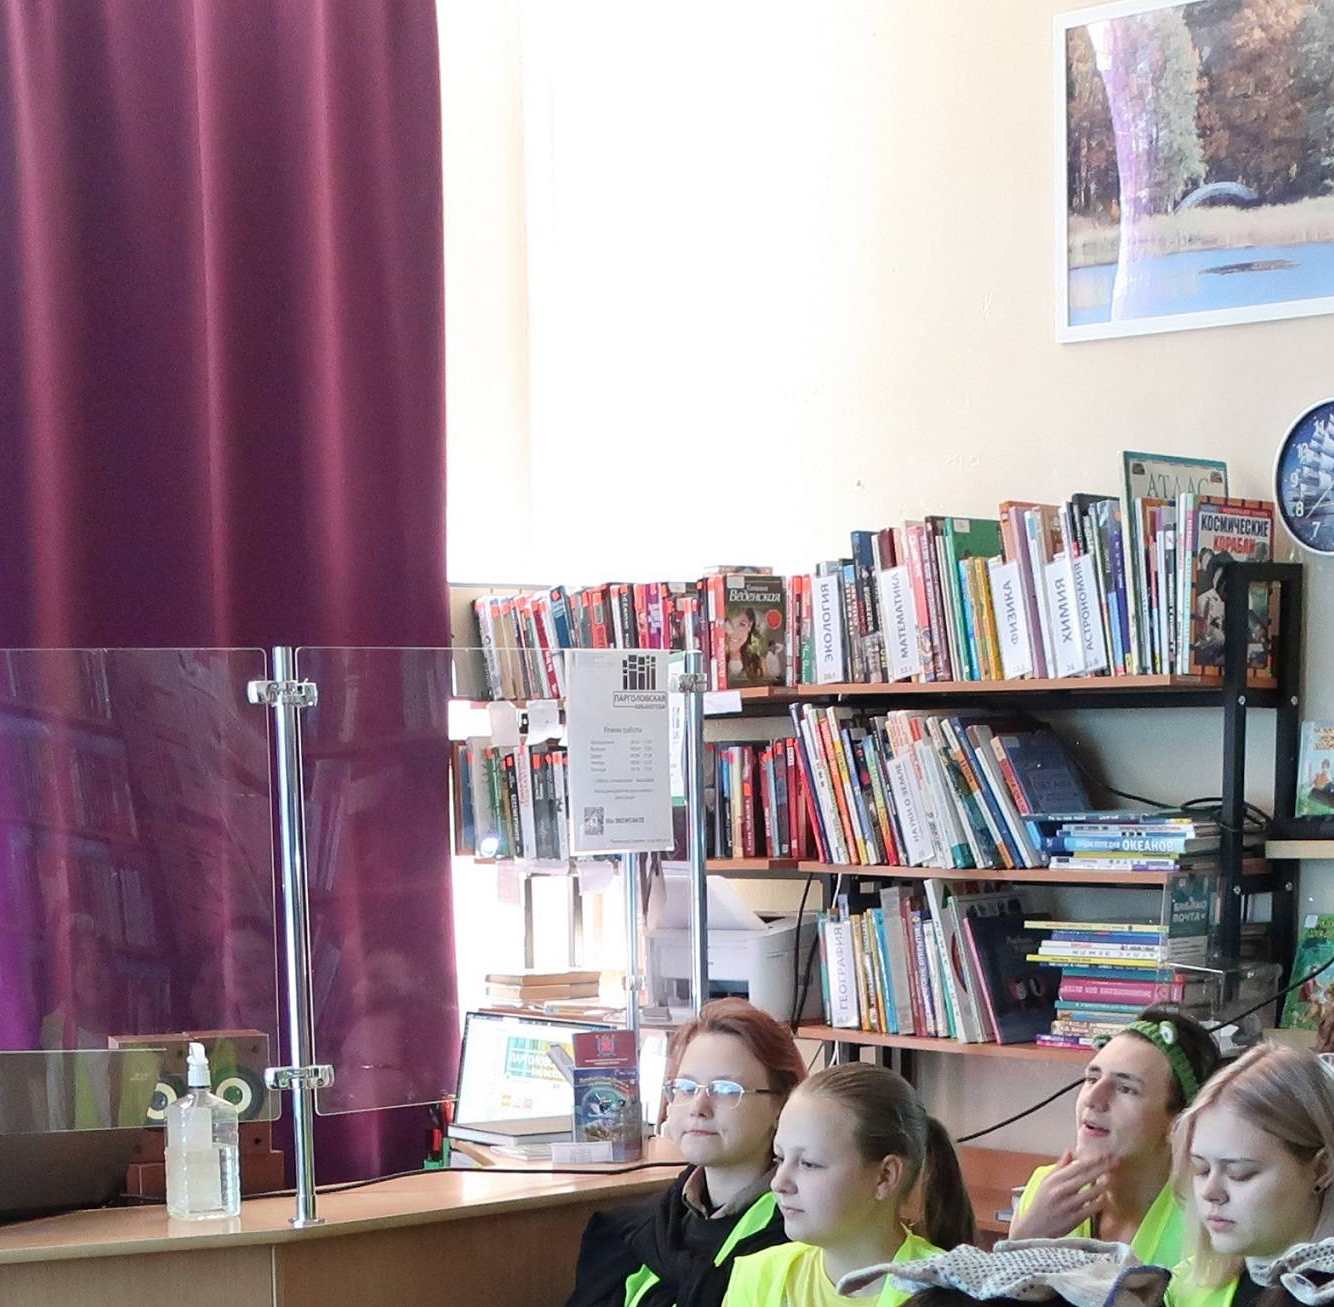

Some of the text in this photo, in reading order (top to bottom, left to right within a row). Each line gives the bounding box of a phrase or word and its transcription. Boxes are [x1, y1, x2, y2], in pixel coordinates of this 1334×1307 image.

[1147, 474, 1209, 499] АТЛАС
[1290, 474, 1299, 487] 9
[1295, 501, 1304, 517] 8
[1200, 513, 1269, 537] КОСМИЧЕСКИЕ
[1311, 521, 1321, 538] 7
[1213, 535, 1256, 556] КОРАБЛИ
[729, 589, 781, 602] Веденская
[1074, 561, 1094, 650] АСТРОНОМИЯ
[824, 583, 836, 662] ЭКОЛОГИЯ
[891, 571, 909, 659] МАТЕМАТИКА
[1002, 579, 1021, 645] ФИЗИКА
[1054, 577, 1073, 645] ХИМИЯ
[613, 694, 667, 702] ПАРГОЛОВСКАЯ
[896, 763, 911, 796] ЗЕМЛЕ
[907, 809, 920, 842] НАУКИ
[1122, 839, 1174, 852] ОКЕАНОВ
[1172, 911, 1199, 923] ПОЧТА
[833, 926, 848, 1011] ГЕОГРАФИЯ
